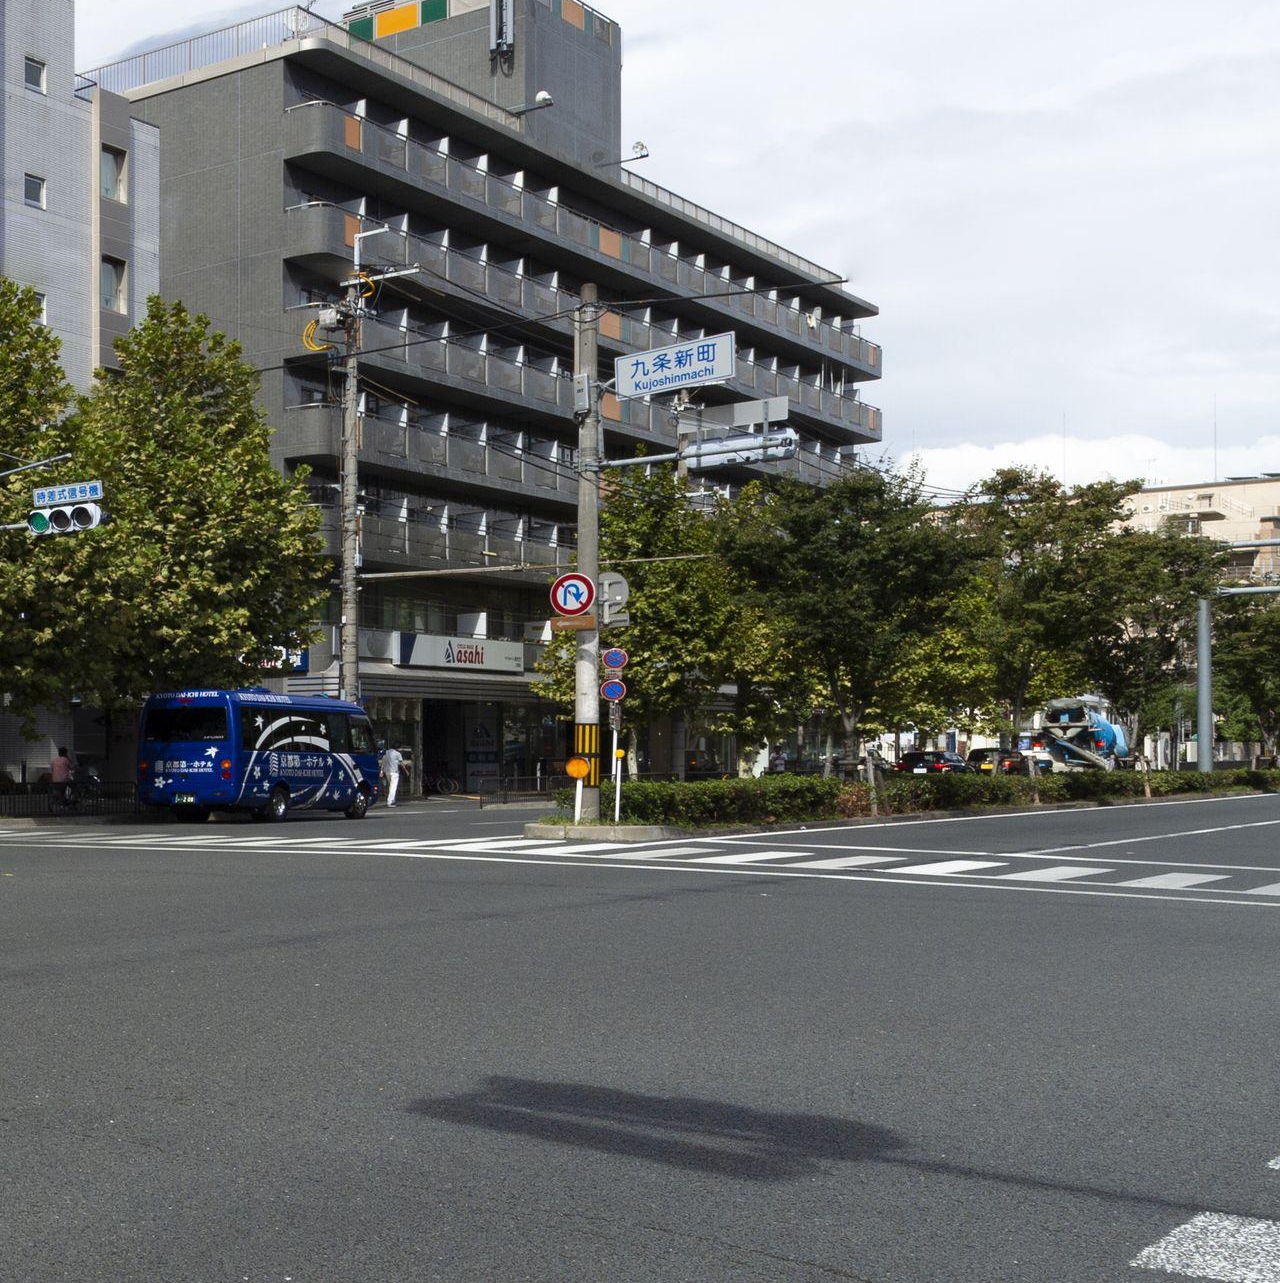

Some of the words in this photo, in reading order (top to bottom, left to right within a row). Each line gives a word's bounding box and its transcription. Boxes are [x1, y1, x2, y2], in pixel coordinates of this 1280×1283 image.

[631, 343, 717, 379] 九条新町
[634, 365, 714, 391] Kujoshinmachi
[36, 484, 99, 503] 時差式信号機
[456, 645, 484, 665] asahi
[280, 754, 325, 768] 京都第一ホテル
